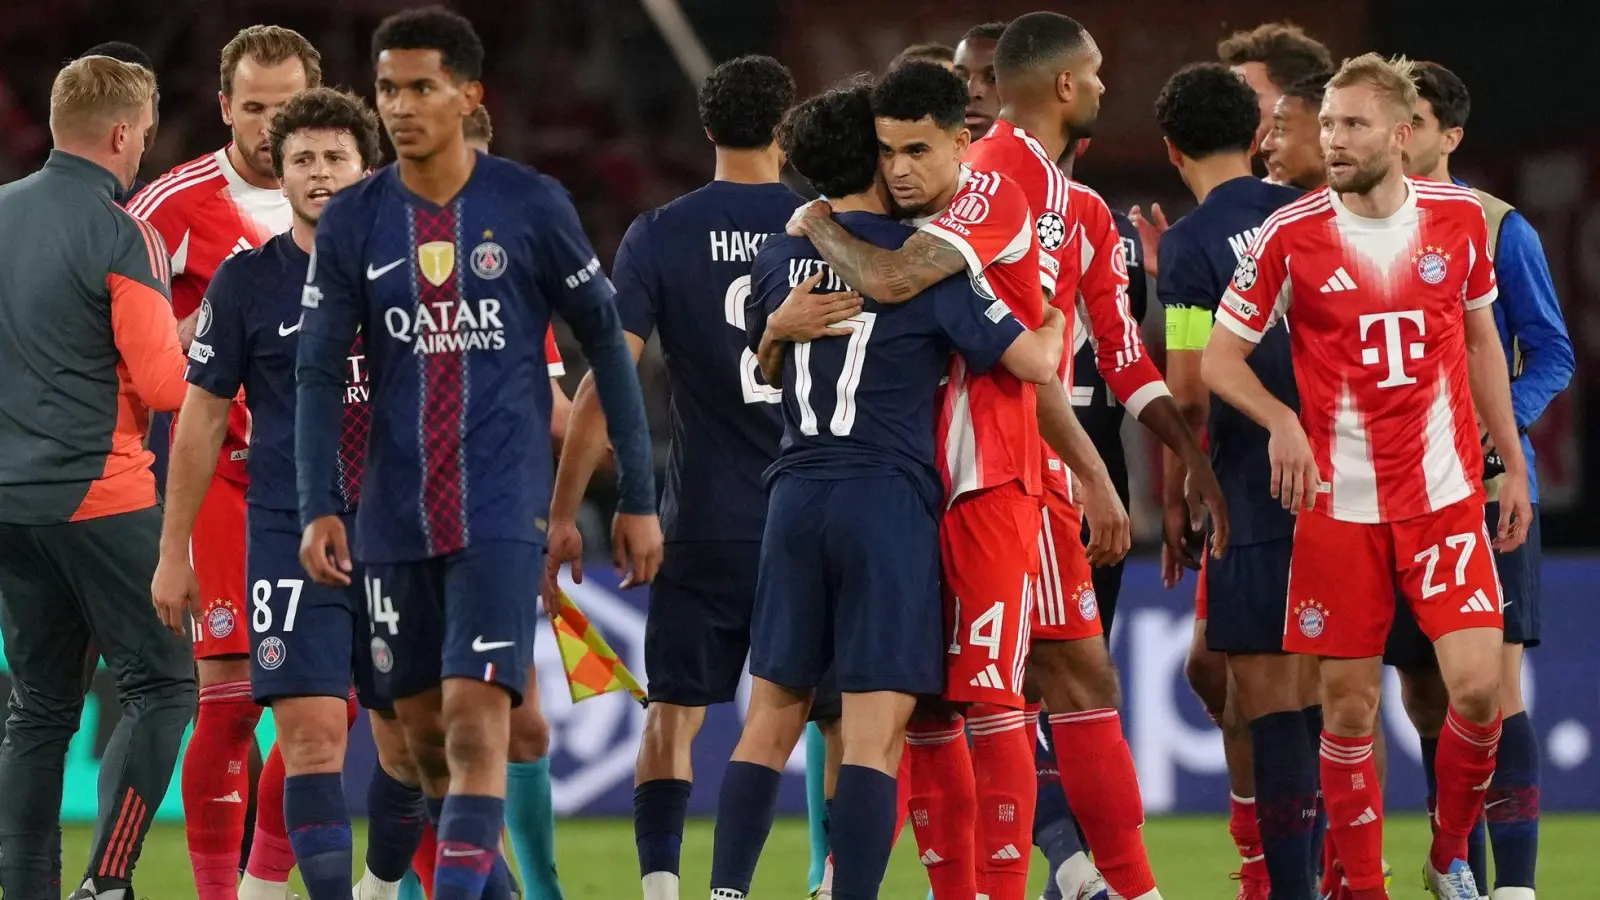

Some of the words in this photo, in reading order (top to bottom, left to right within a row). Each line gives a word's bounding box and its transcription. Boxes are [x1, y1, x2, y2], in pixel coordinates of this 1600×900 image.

[709, 230, 776, 262] HAK
[384, 298, 504, 343] QATAR
[413, 329, 506, 355] AIRWAYS
[1358, 309, 1427, 389] T
[1413, 533, 1476, 600] 27
[252, 578, 304, 633] 87
[948, 596, 1005, 660] 14
